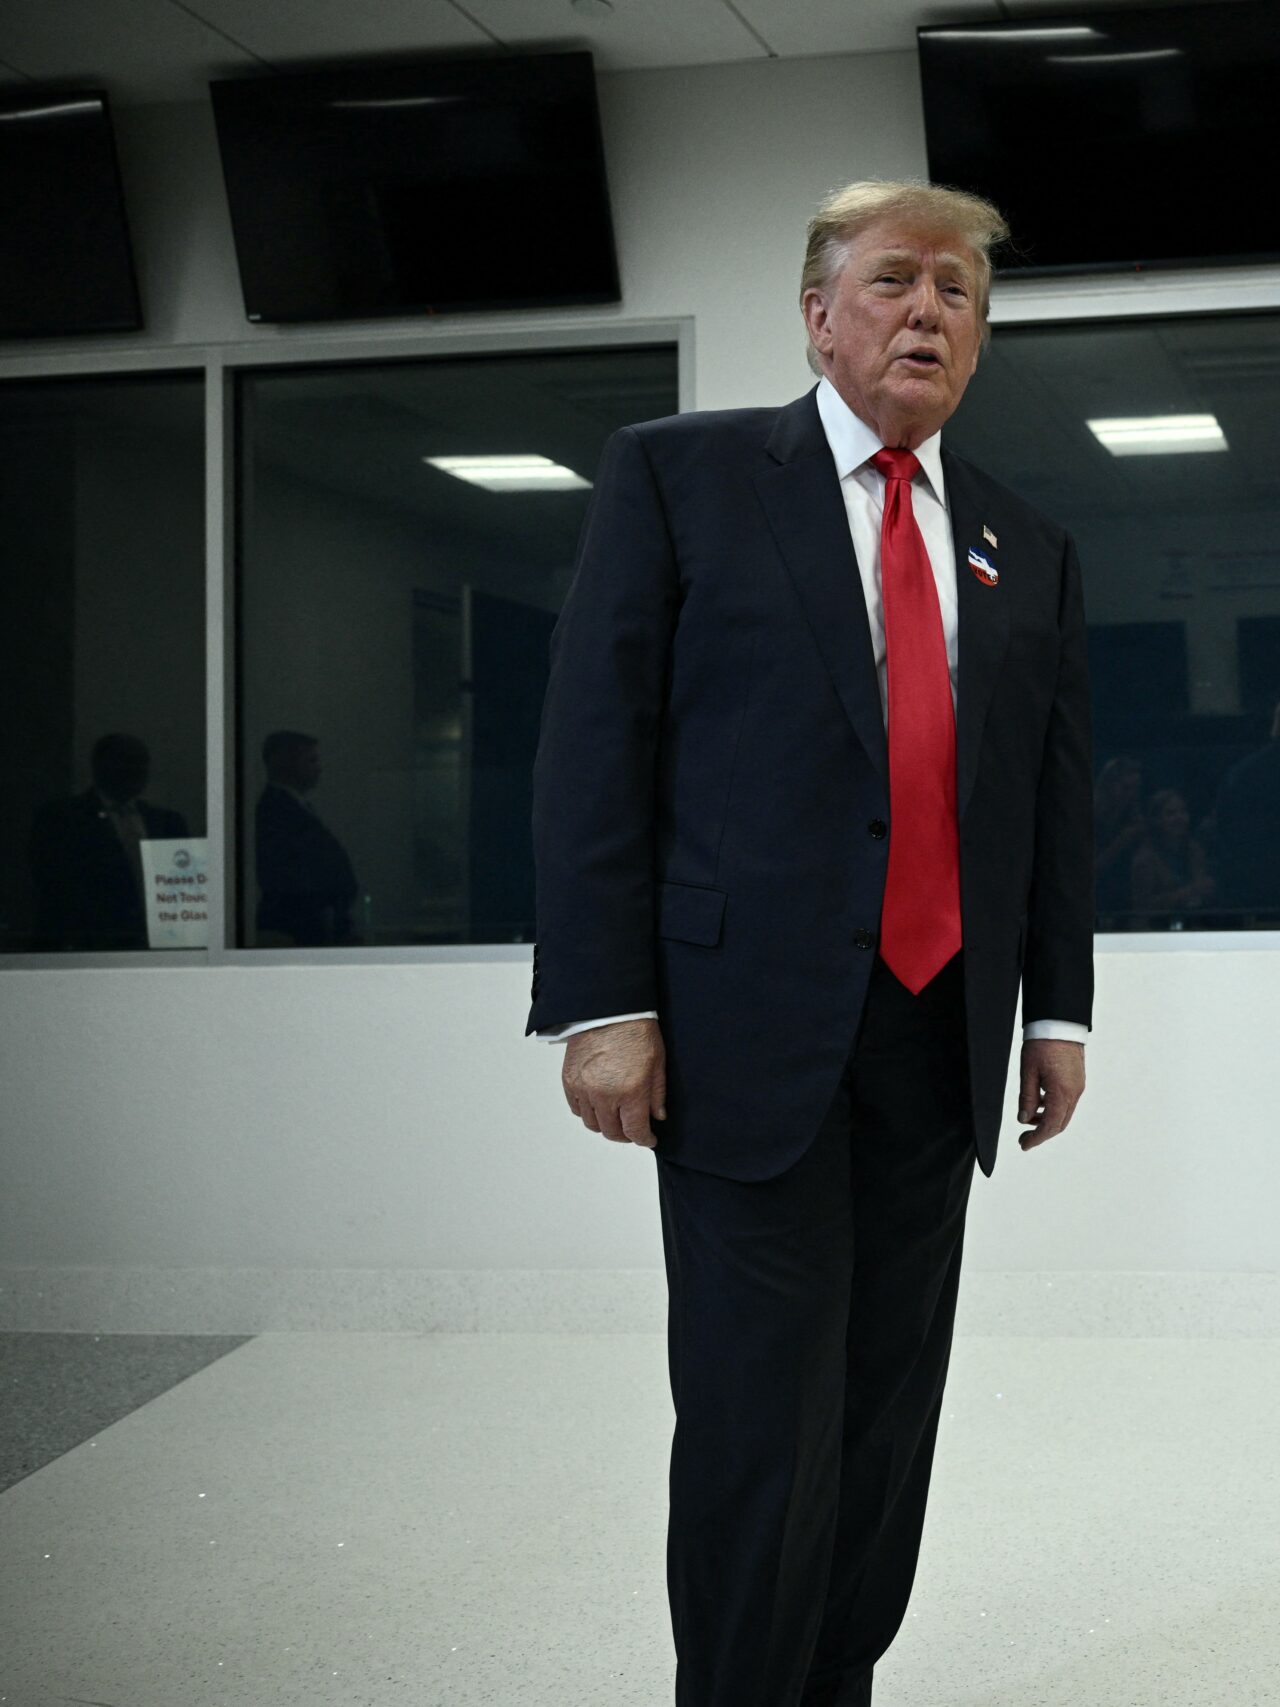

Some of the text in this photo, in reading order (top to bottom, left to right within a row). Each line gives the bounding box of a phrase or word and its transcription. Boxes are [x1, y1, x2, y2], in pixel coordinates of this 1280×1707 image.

[155, 873, 208, 885] Please D
[156, 892, 207, 904] Not Touc
[158, 910, 208, 922] the Glas
